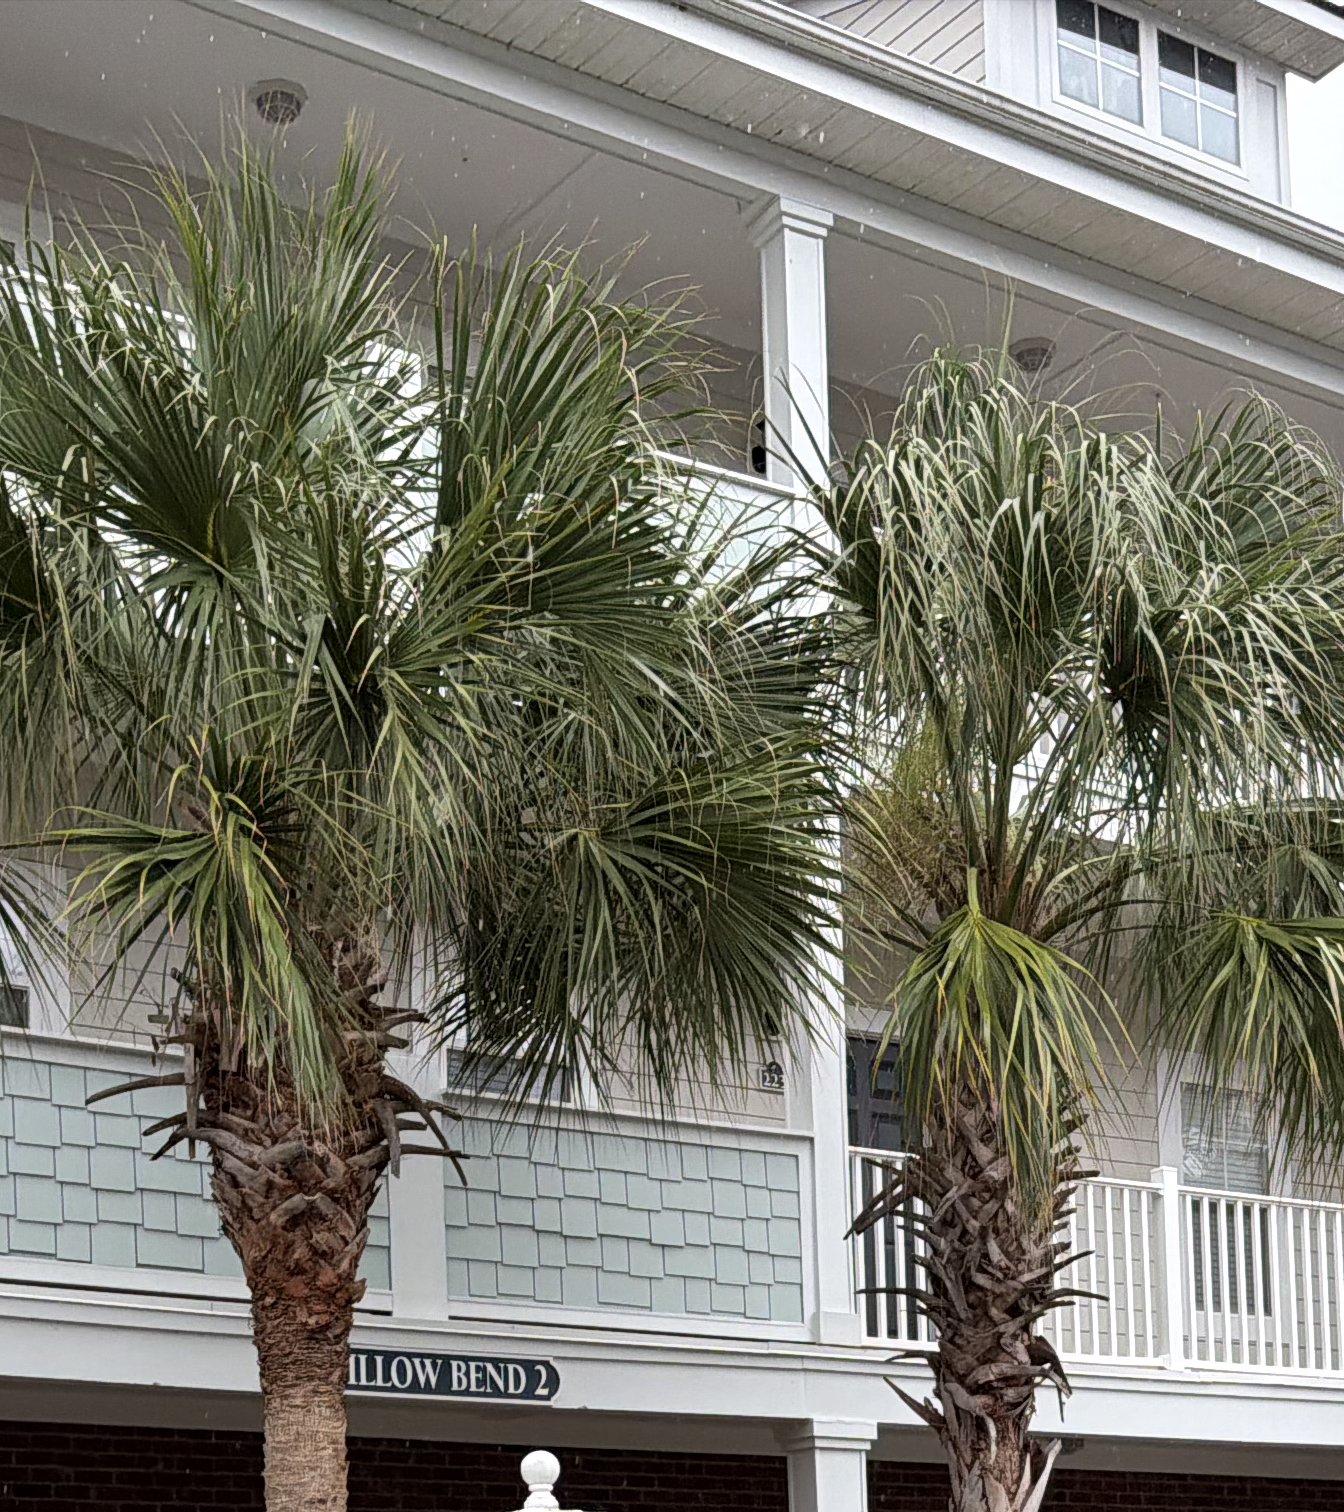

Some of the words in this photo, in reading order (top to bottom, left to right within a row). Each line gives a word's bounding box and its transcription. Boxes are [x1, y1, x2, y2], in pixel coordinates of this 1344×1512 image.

[347, 1353, 443, 1389] ILLOW
[450, 1360, 527, 1394] BEND
[534, 1364, 549, 1396] 2
